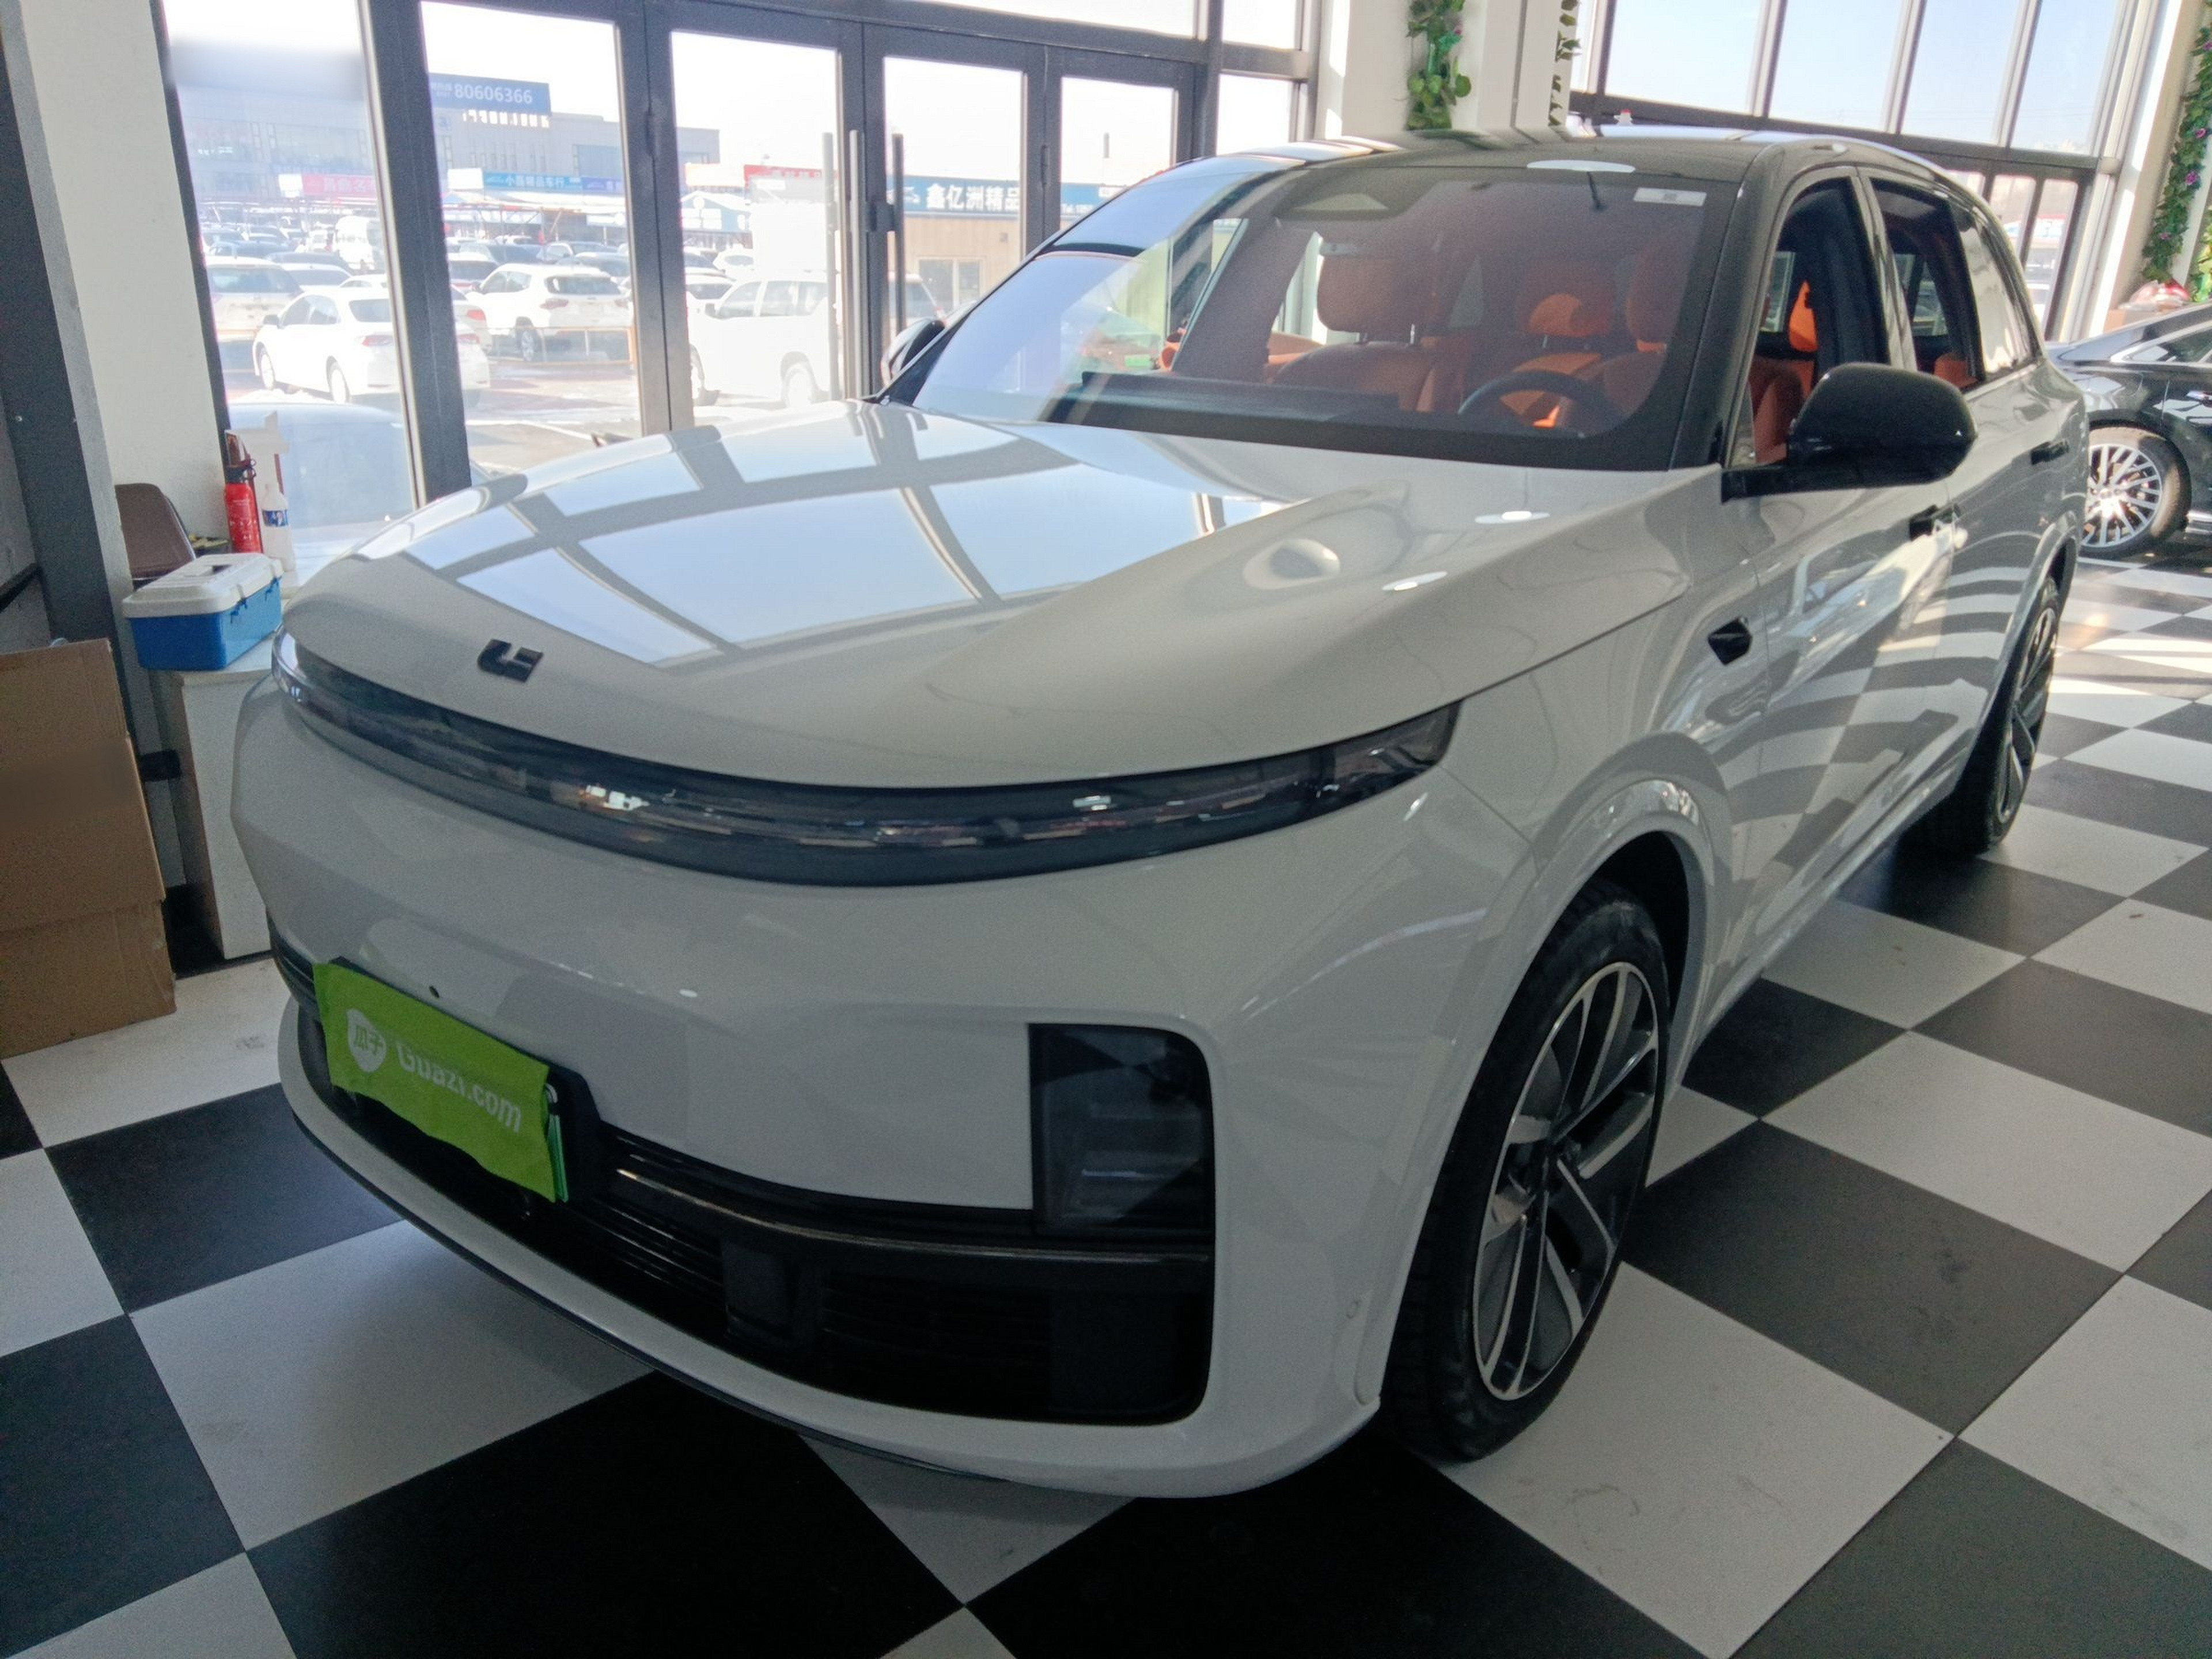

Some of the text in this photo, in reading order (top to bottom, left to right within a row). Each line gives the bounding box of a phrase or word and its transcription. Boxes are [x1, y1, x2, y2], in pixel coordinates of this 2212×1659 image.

[454, 84, 532, 104] 80606366
[926, 183, 1020, 211] 鑫亿洲精品
[353, 1024, 385, 1056] 瓜子
[396, 1040, 522, 1134] Guazi.com
